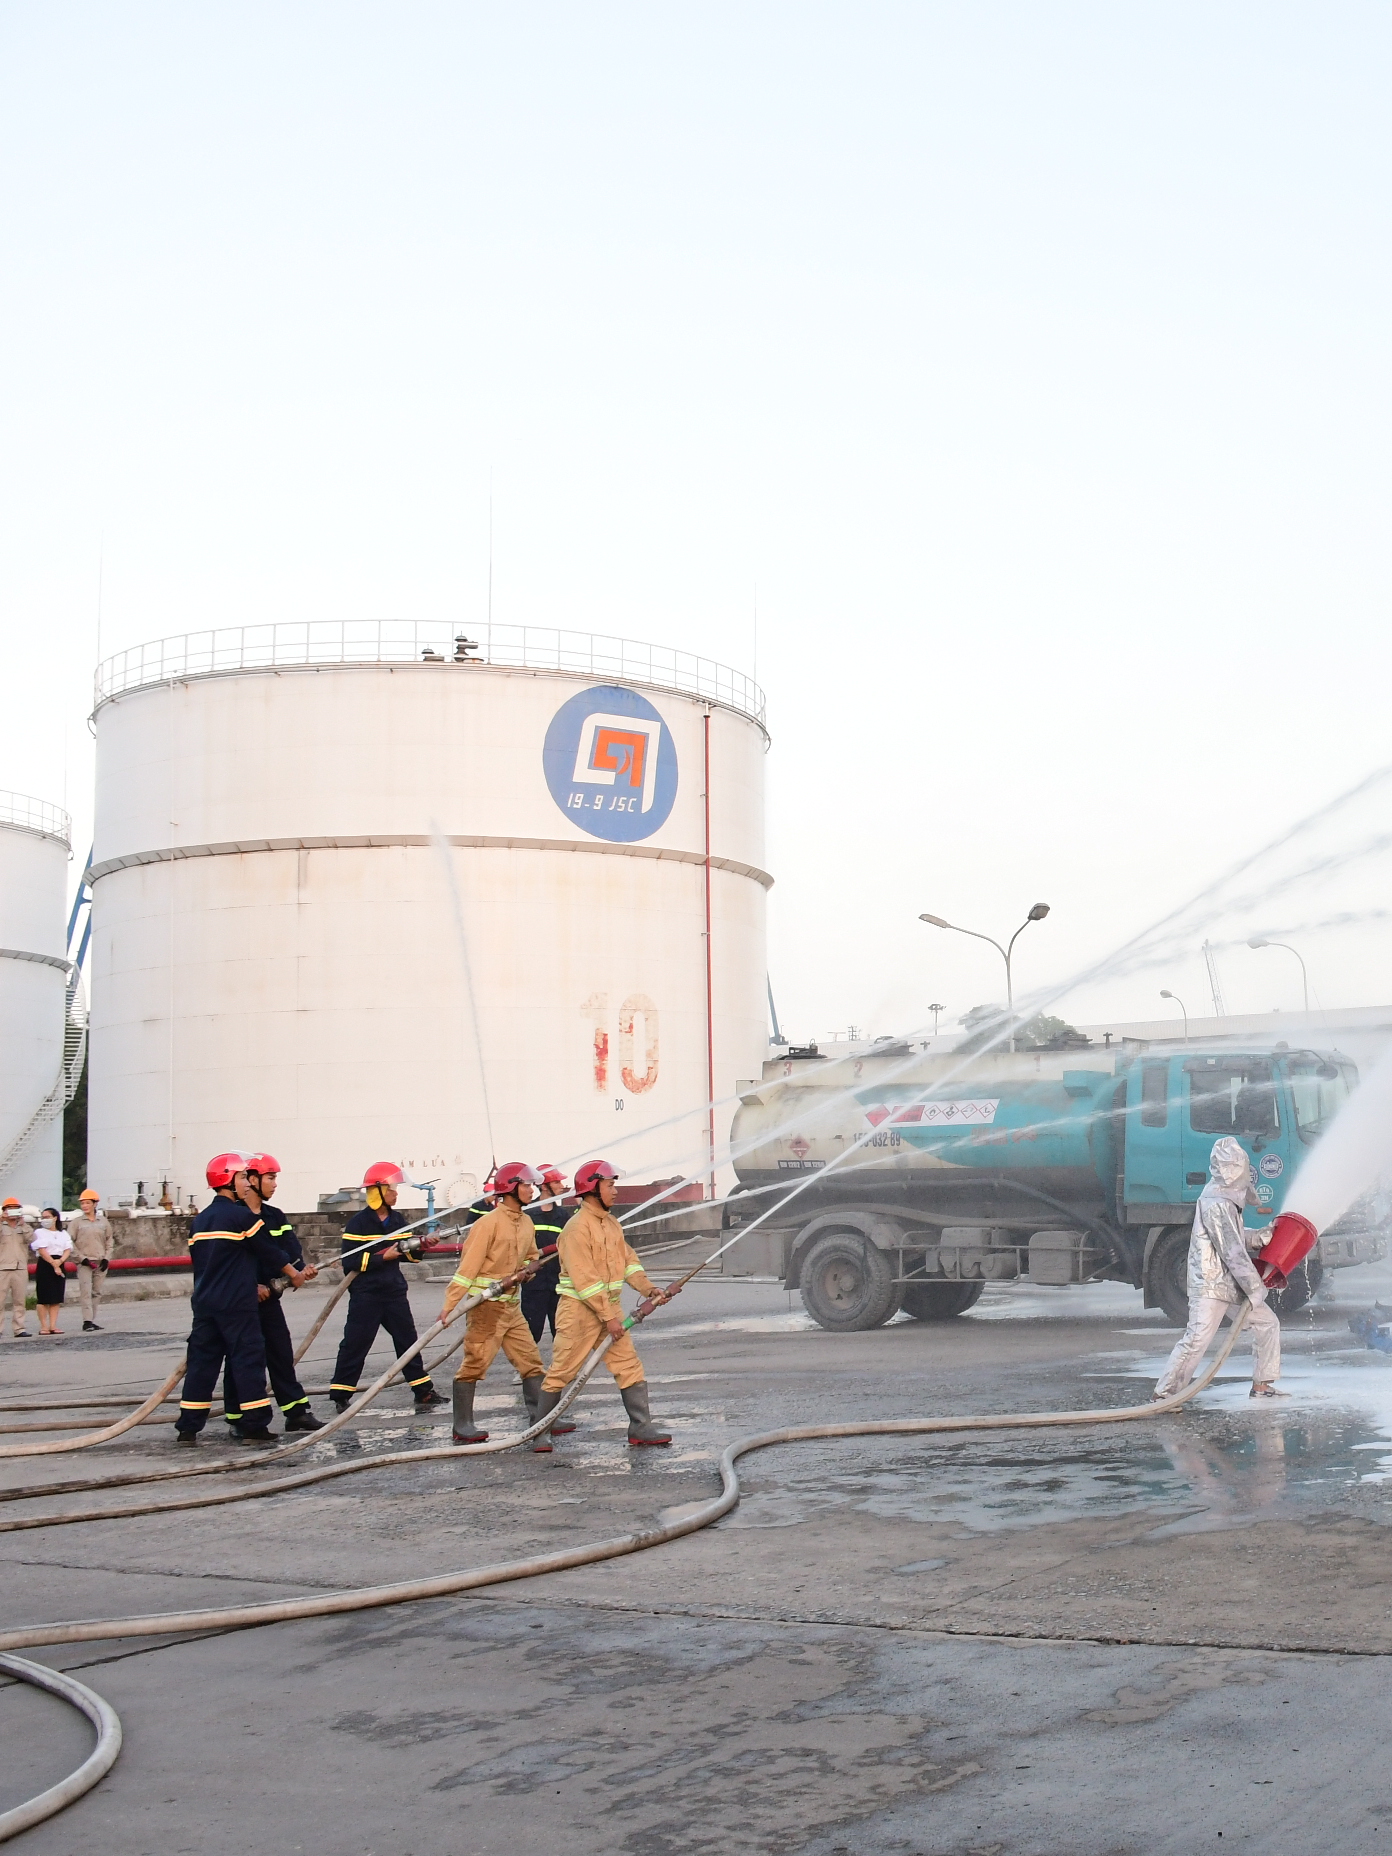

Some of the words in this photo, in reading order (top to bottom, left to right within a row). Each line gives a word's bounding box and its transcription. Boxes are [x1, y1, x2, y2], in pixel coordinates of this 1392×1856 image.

[567, 793, 604, 810] 19-9
[608, 796, 638, 813] JSC
[579, 991, 660, 1096] 10
[783, 1061, 793, 1077] 3
[615, 1098, 625, 1111] DO
